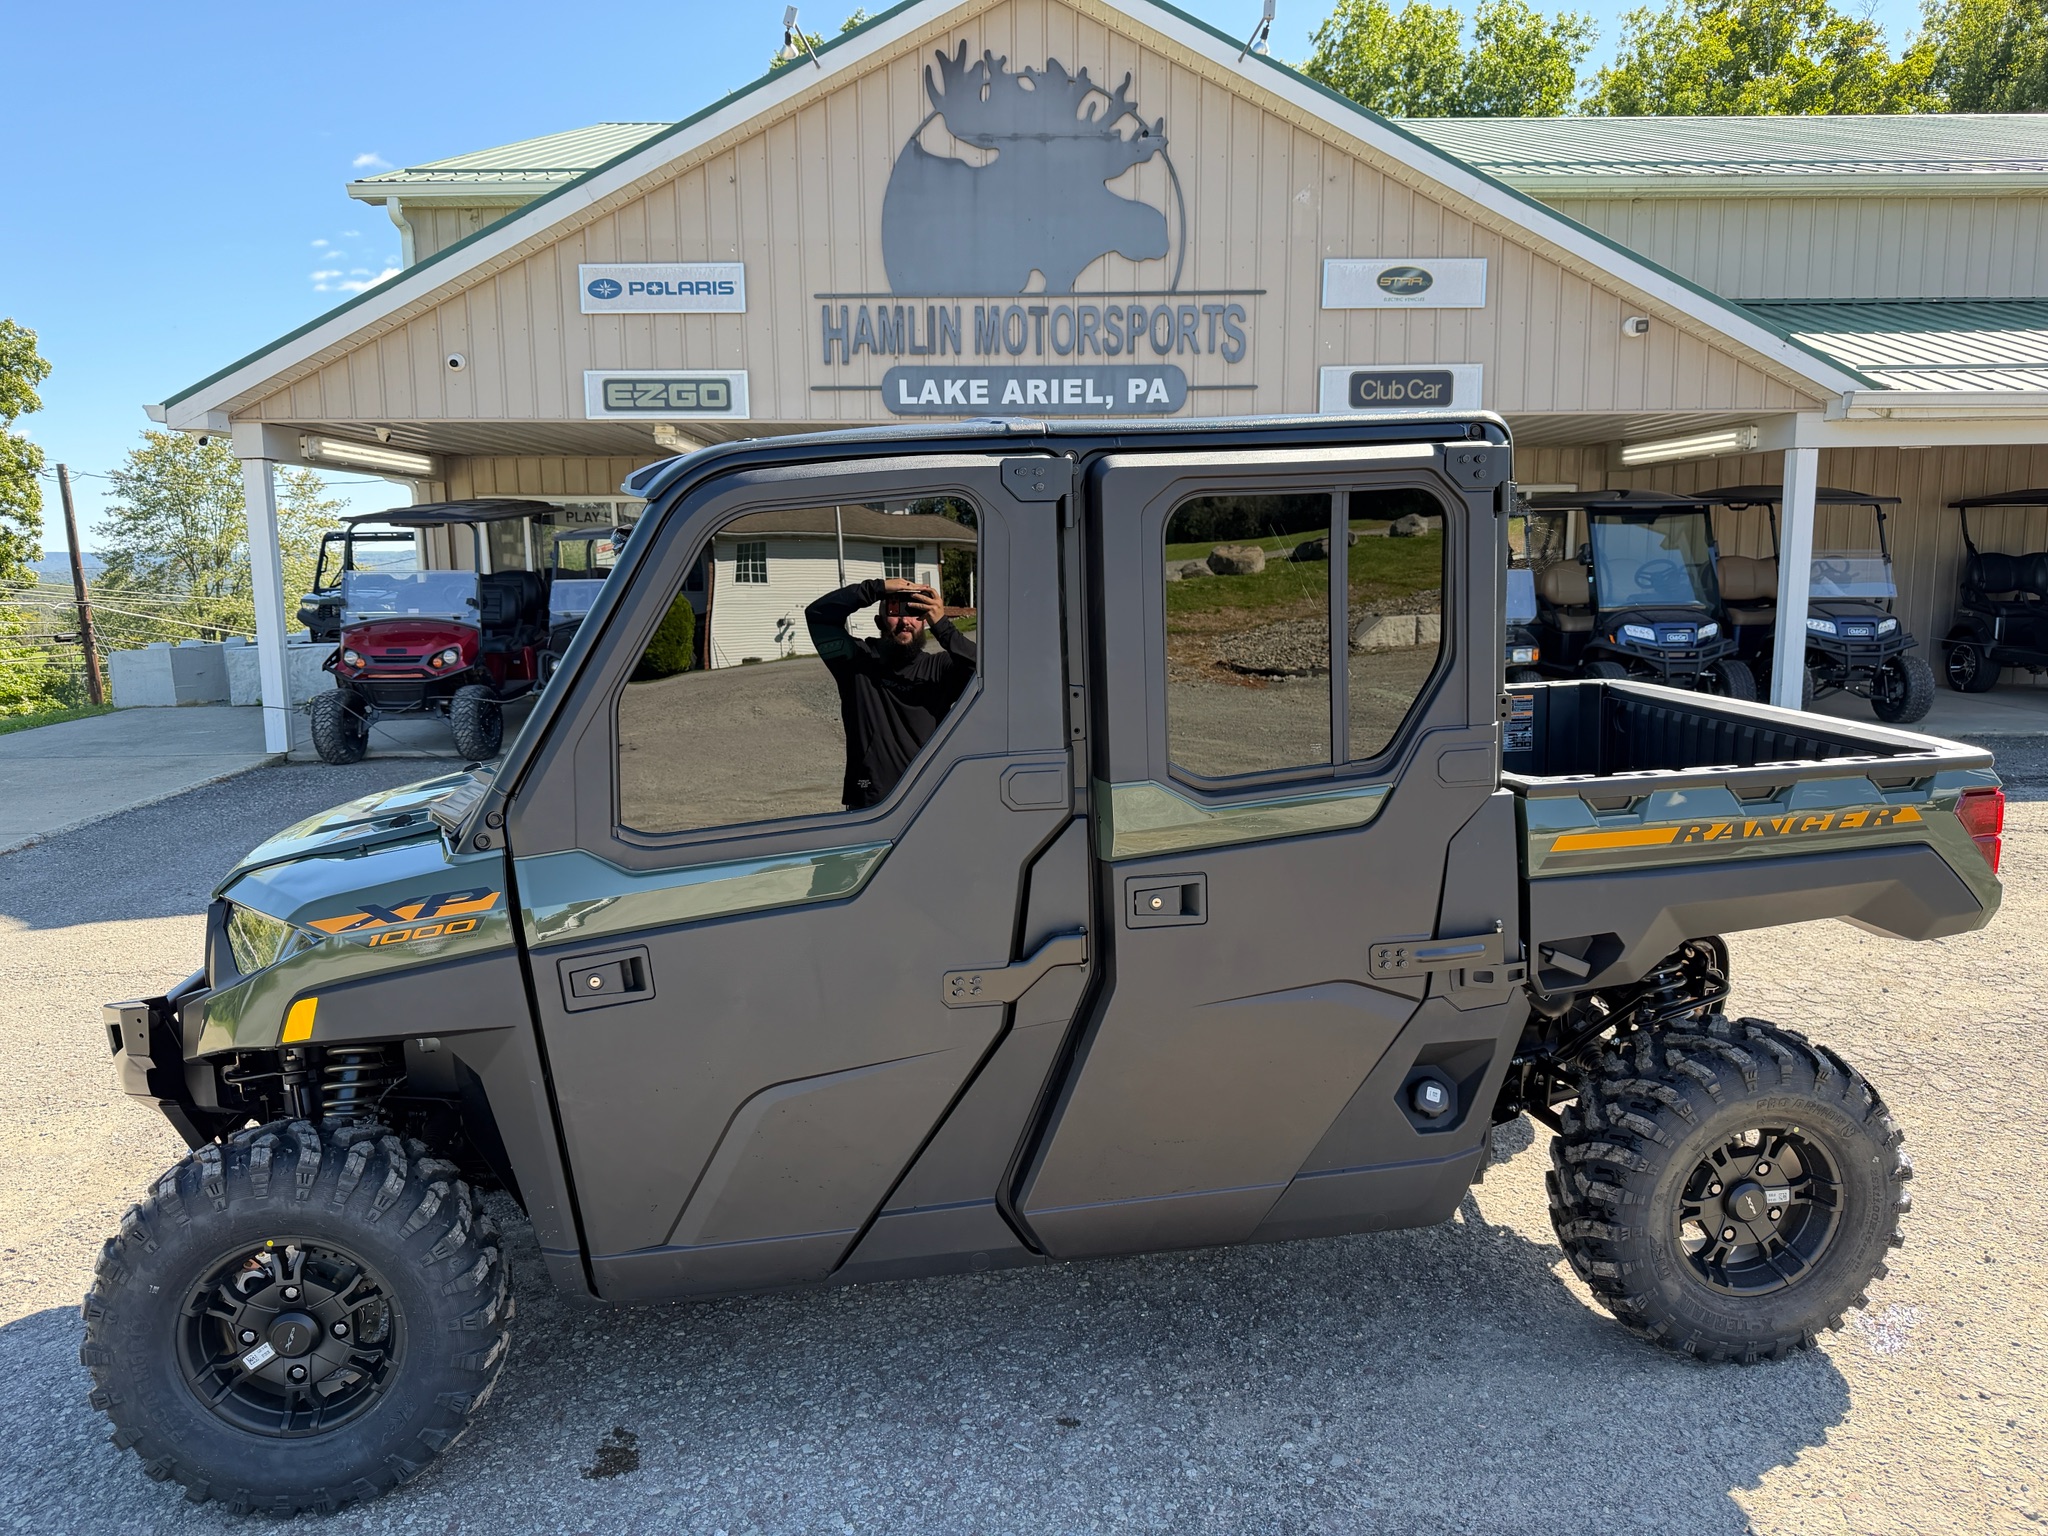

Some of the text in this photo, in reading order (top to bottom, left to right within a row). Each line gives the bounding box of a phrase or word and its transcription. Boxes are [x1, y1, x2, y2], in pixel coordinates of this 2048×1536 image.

[628, 281, 735, 296] POLARIS
[1379, 276, 1423, 287] STAR
[822, 304, 1246, 365] HAMLIN MOTORSPORTS
[607, 383, 728, 407] EZGO
[898, 378, 1170, 410] LAKE ARIEL, PA
[1360, 379, 1442, 400] Club Car
[566, 511, 600, 523] PLAY
[1671, 806, 1902, 845] RANGER
[336, 887, 494, 932] XP
[369, 919, 476, 947] 1000
